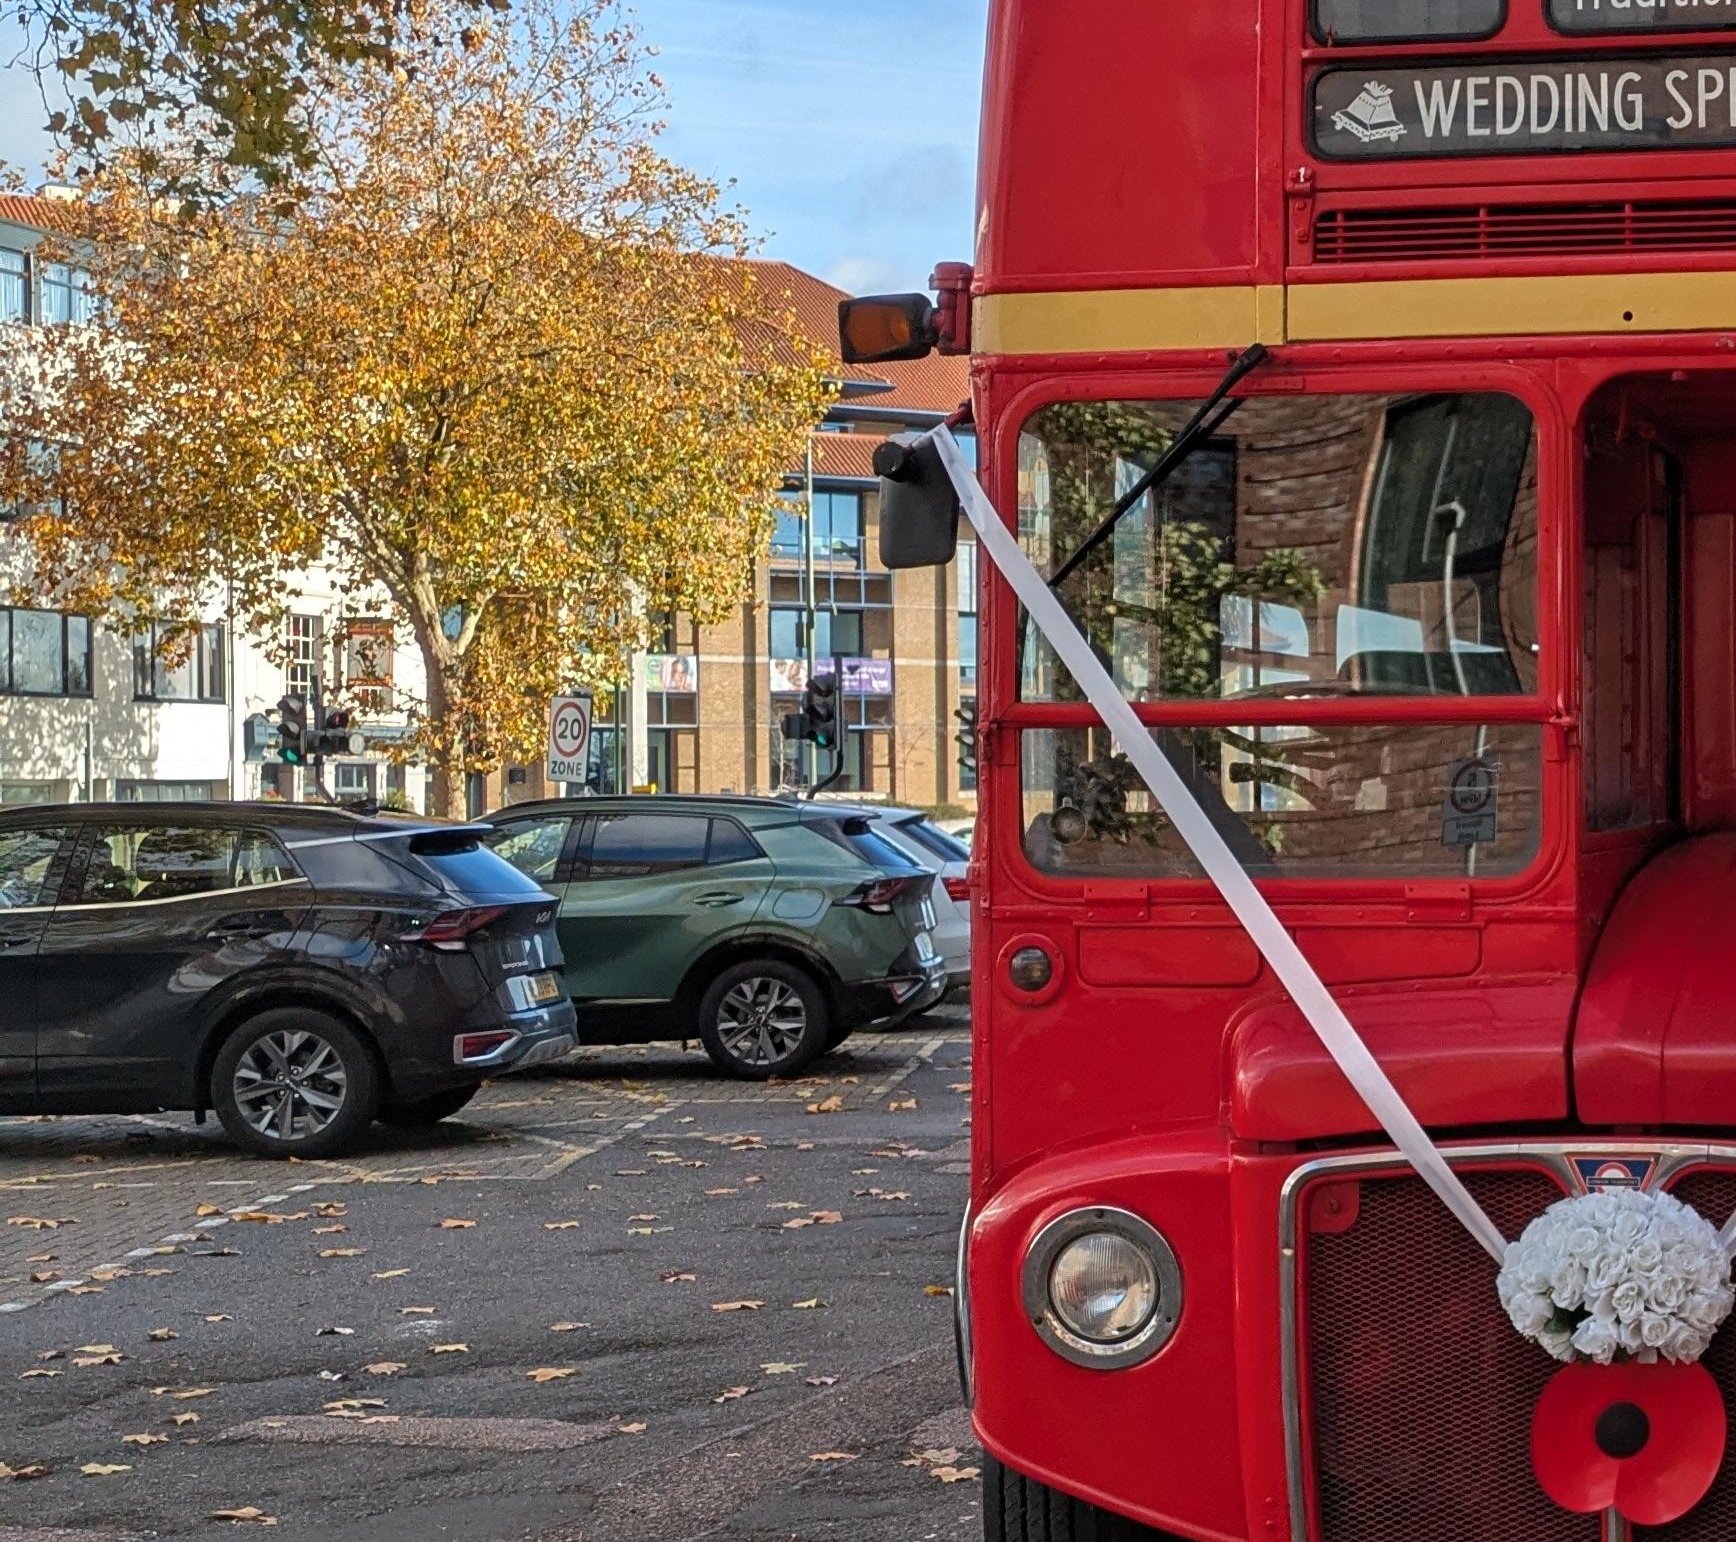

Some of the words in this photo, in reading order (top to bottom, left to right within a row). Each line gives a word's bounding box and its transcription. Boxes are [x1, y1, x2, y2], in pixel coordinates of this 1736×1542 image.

[1414, 72, 1643, 138] WEDDING
[558, 717, 582, 740] 20
[551, 761, 582, 776] ZONE
